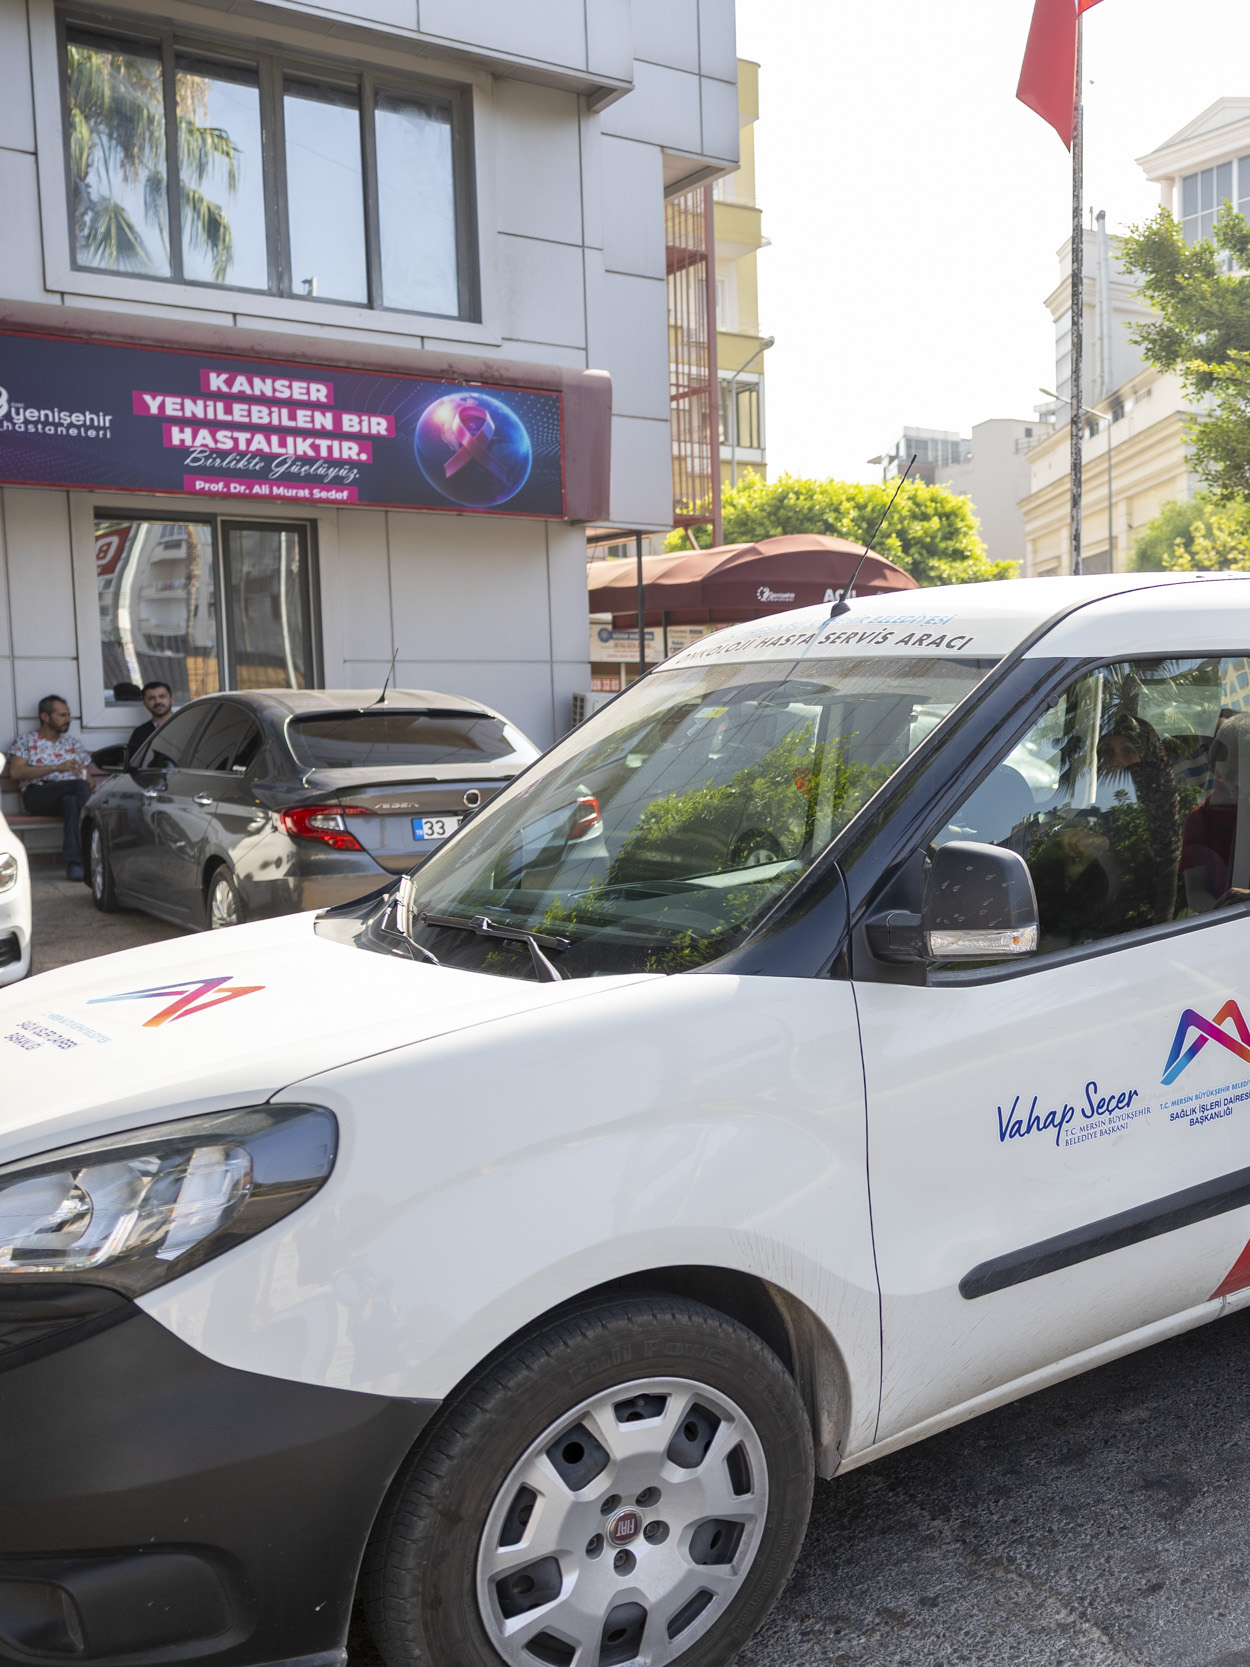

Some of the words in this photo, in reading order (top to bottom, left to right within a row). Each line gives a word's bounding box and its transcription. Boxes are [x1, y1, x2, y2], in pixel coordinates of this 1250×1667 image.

[209, 372, 328, 402] KANSER
[11, 407, 112, 428] yenişehir
[142, 394, 333, 431] YENİLEBİLEN
[342, 414, 388, 436] BİR
[3, 420, 111, 439] hastaneleri
[171, 426, 368, 461] HASTALIKTIR.
[184, 447, 265, 471] Birlikte
[268, 454, 360, 484] Güçlüyüz.
[195, 481, 227, 492] Prof.
[230, 483, 249, 494] Dr.
[252, 484, 270, 495] Ali
[273, 486, 309, 498] Murat
[312, 488, 348, 501] Sedef
[754, 632, 817, 649] HASTA
[818, 628, 895, 645] SERVİS
[894, 632, 974, 651] ARACI
[424, 820, 446, 836] 33
[1160, 1102, 1170, 1110] T.C.
[1171, 1094, 1194, 1108] MERSİN
[1195, 1084, 1231, 1101] BÜYÜKŞEHİR
[1169, 1107, 1197, 1121] SAĞLIK
[1198, 1097, 1222, 1114] İŞLERİ
[1223, 1089, 1250, 1106] DAİRESİ
[997, 1095, 1075, 1147] Vahap
[1081, 1081, 1139, 1119] Seçer
[1079, 1119, 1106, 1133] MERSİN
[1108, 1107, 1151, 1125] BÜYÜKŞEHİR
[1189, 1107, 1233, 1127] BAŞKANLIĞI
[1065, 1131, 1098, 1147] BELEDİYE
[1099, 1122, 1129, 1137] BAŞKANI
[616, 1518, 635, 1537] FIAT
